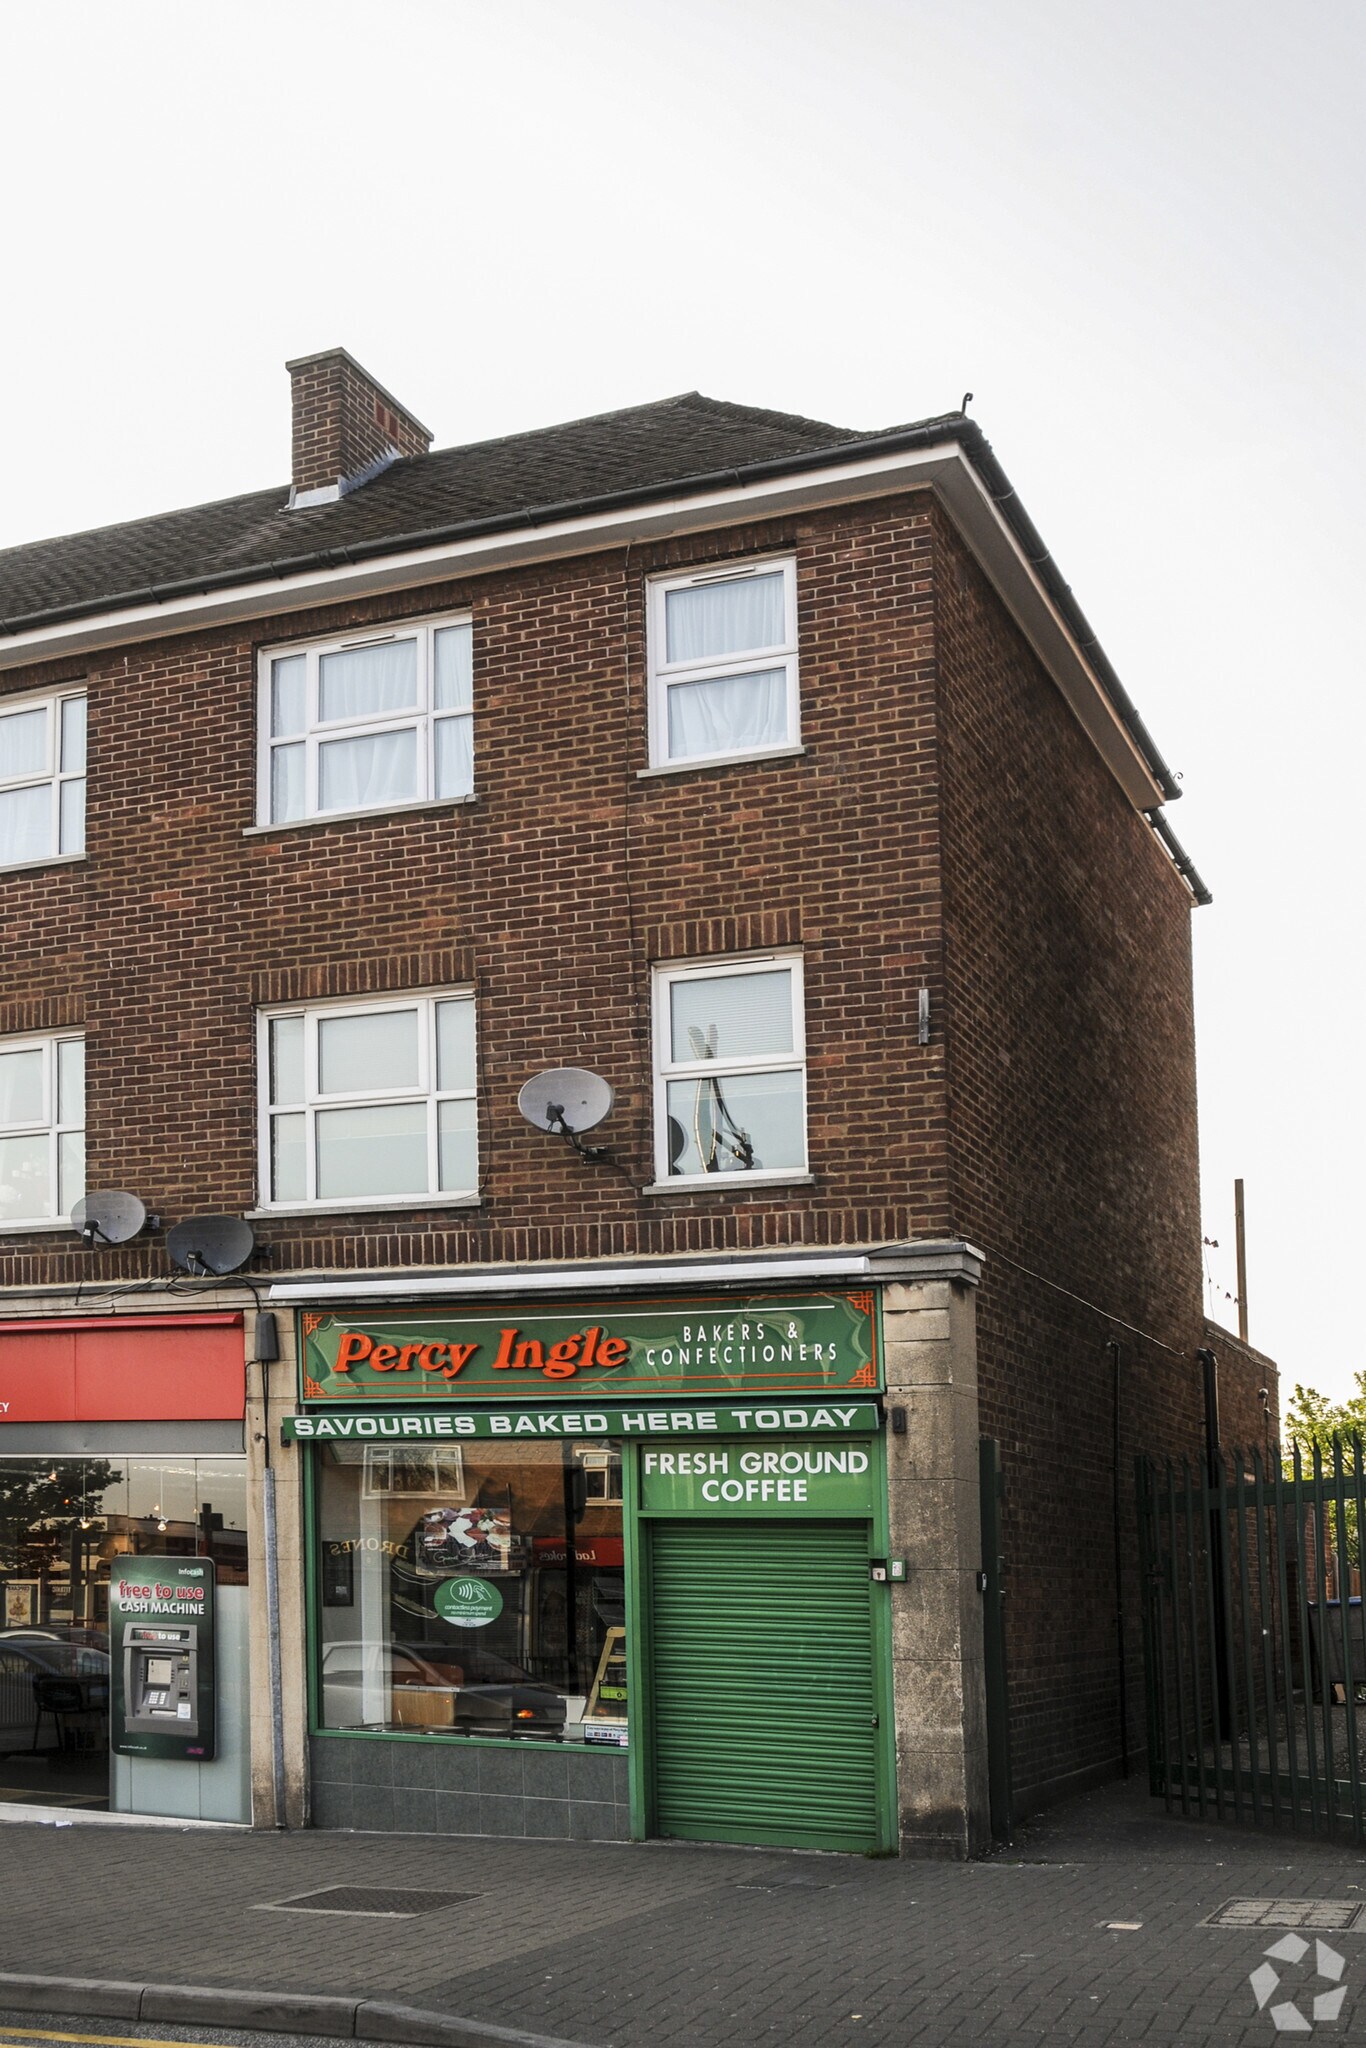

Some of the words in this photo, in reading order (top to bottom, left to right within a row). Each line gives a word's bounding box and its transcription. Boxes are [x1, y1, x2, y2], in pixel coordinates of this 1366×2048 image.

[683, 1323, 765, 1343] BAKERS
[787, 1321, 798, 1339] &
[332, 1332, 479, 1378] Percy
[491, 1326, 629, 1379] Ingle
[646, 1342, 836, 1366] CONFECTIONERS
[294, 1416, 476, 1437] SAVOURIES
[489, 1413, 608, 1433] BAKED
[622, 1411, 718, 1431] HERE
[731, 1408, 858, 1429] TODAY
[645, 1453, 729, 1474] FRESH
[739, 1451, 869, 1474] GROUND
[701, 1479, 808, 1502] COFFEE
[118, 1579, 152, 1599] free
[155, 1582, 173, 1599] to
[176, 1586, 205, 1600] use
[119, 1601, 148, 1613] CASH
[150, 1602, 205, 1615] MACHINE
[158, 1632, 166, 1640] to
[167, 1633, 181, 1641] use
